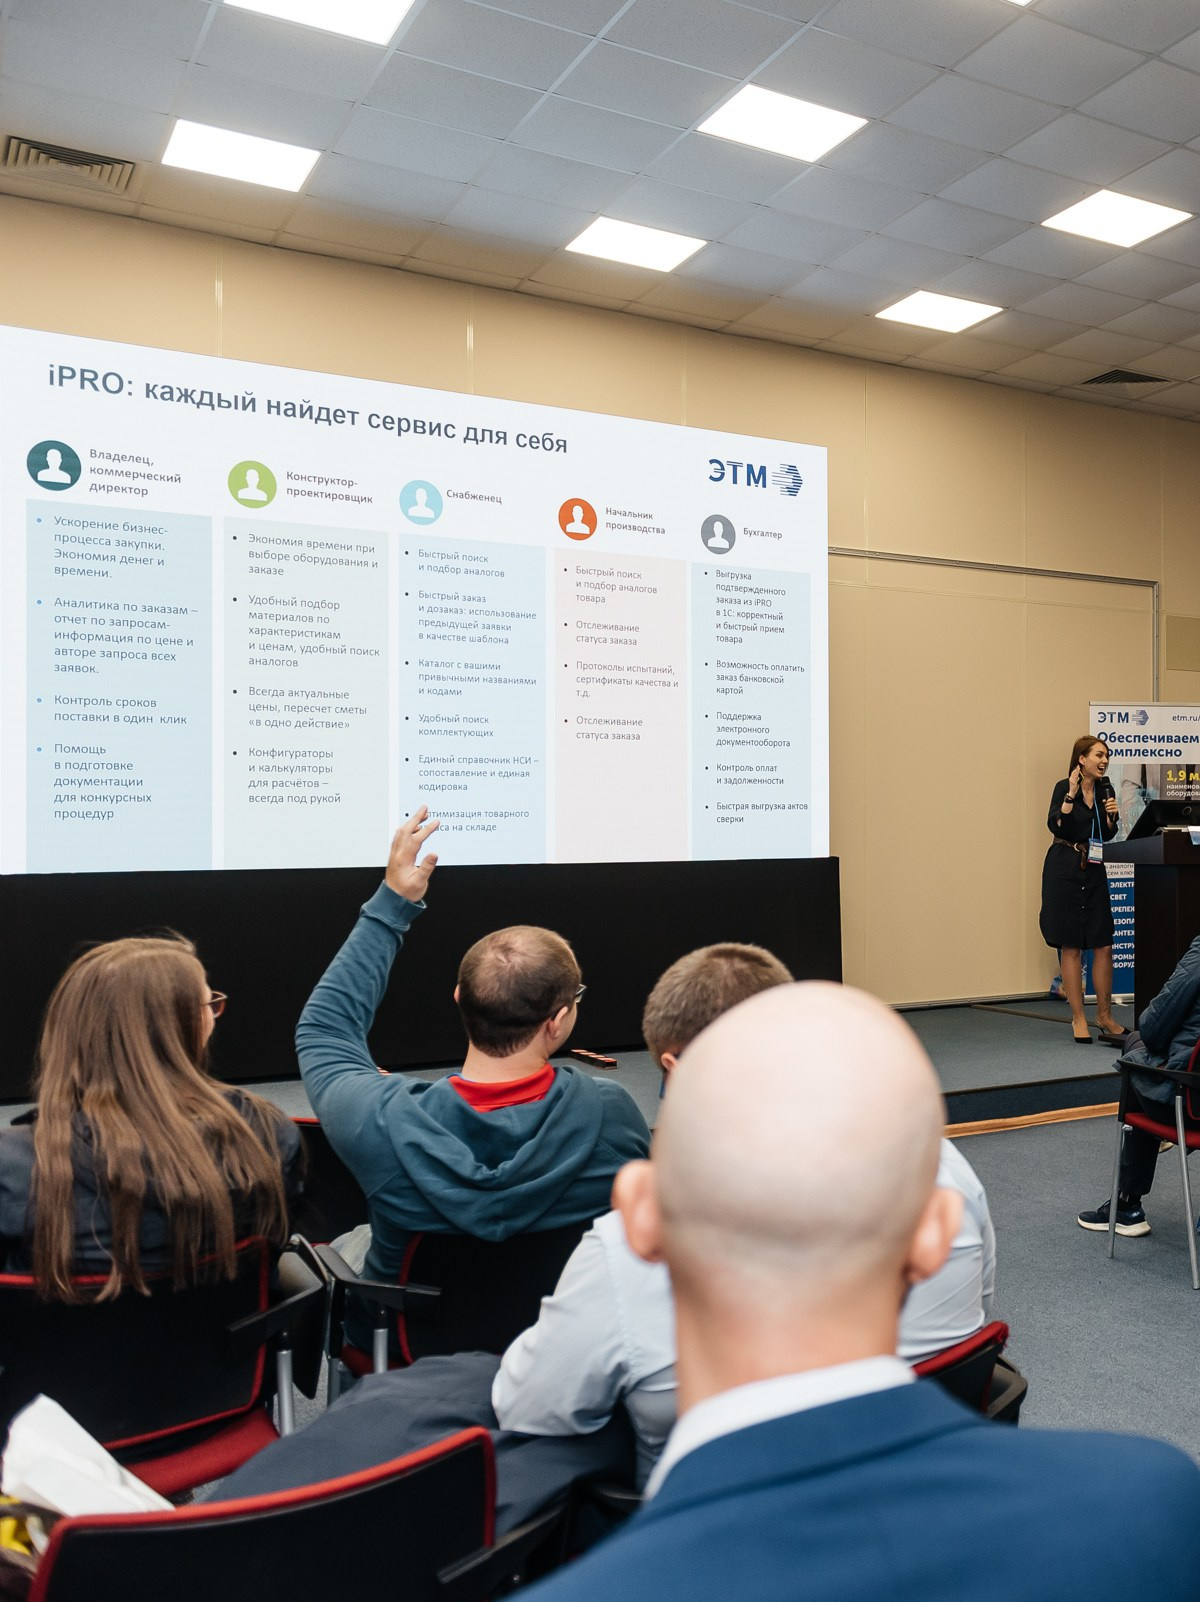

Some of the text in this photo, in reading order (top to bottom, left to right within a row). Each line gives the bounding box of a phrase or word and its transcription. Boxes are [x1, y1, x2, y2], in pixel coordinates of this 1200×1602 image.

[50, 364, 567, 453] iPRO: каждый найдет сервис для себя
[90, 448, 154, 466] Владелец,
[90, 467, 181, 483] коммерческий
[708, 458, 767, 488] ЭТМ
[286, 471, 357, 488] Конструктор-
[89, 483, 148, 497] директор
[286, 488, 373, 504] проектировщик
[446, 489, 502, 504] Снабженец
[606, 507, 653, 519] Начальник
[54, 516, 168, 534] Ускорение бизнес-
[605, 522, 665, 534] производства
[743, 527, 783, 540] Бухгалтер
[54, 534, 165, 550] процесса закупки.
[249, 533, 352, 551] Экономия времени
[54, 548, 154, 565] Экономия денег
[249, 549, 368, 567] выборе оборудования
[418, 549, 488, 562] Быстрый поиск
[54, 566, 112, 577] времени.
[248, 565, 284, 575] заказе
[427, 564, 505, 577] подбор аналогов
[576, 565, 642, 579] Быстрый поиск
[716, 569, 752, 580] Выгрузка
[584, 581, 657, 593] подбор аналогов
[715, 584, 786, 595] подтвержденного
[418, 590, 459, 601] Быстрый
[576, 594, 606, 604] товара
[54, 597, 188, 614] Аналитика заказам
[248, 594, 340, 611] Удобный подбор
[716, 596, 772, 607] заказа iPRO
[248, 612, 314, 622] материалов
[426, 605, 537, 619] дозаказ: использование
[736, 611, 783, 620] корректный
[54, 615, 170, 629] отчет запросам-
[419, 619, 511, 631] предыдущей заявки
[576, 620, 640, 632] Отслеживание
[723, 621, 785, 633] быстрый прием
[54, 630, 183, 646] информация цене
[248, 627, 341, 639] характеристикам
[426, 633, 509, 644] качестве шаблона
[575, 635, 637, 645] статуса заказа
[715, 635, 743, 644] товара
[54, 647, 176, 661] авторе запроса всех
[259, 643, 380, 656] ценам, удобный поиск
[248, 657, 299, 667] аналогов
[418, 659, 501, 670] Каталог вашими
[716, 660, 805, 672] Возможность оплатить
[54, 664, 99, 673] заявок.
[576, 661, 675, 675] Протоколы испытаний,
[418, 673, 480, 682] привычными
[576, 676, 671, 687] сертификаты качества
[739, 673, 784, 683] банковской
[249, 686, 349, 699] Всегда актуальные
[427, 688, 462, 696] кодами
[716, 685, 743, 695] картой
[54, 695, 157, 708] Контроль сроков
[249, 704, 367, 714] цены, пересчет сметы
[54, 713, 187, 724] поставки один клик
[418, 713, 460, 723] Удобный
[576, 715, 643, 726] Отслеживание
[716, 711, 762, 721] Поддержка
[1098, 712, 1129, 723] ЭТМ
[264, 719, 291, 728] одно
[294, 717, 349, 728] действие»
[418, 729, 493, 737] комплектующих
[716, 726, 770, 734] электронного
[576, 732, 609, 741] статуса
[1098, 731, 1199, 743] Обеспечиваем
[716, 738, 790, 748] документооборота
[54, 743, 106, 755] Помощь
[249, 748, 333, 759] Конфигураторы
[1108, 748, 1182, 757] омплексно
[418, 754, 455, 764] Единый
[513, 756, 531, 764] НСИ
[65, 762, 133, 771] подготовке
[258, 764, 332, 774] калькуляторы
[716, 763, 754, 772] Контроль
[724, 777, 784, 785] задолженности
[1166, 770, 1187, 782] 1,9
[53, 778, 143, 788] документации
[272, 778, 320, 789] расчётов
[419, 784, 467, 792] кодировка
[80, 794, 151, 804] конкурсных
[248, 793, 341, 804] всегда рукой
[717, 802, 749, 811] Быстрая
[751, 803, 786, 811] выгрузка
[54, 810, 114, 820] процедур
[428, 811, 481, 819] птимизация
[716, 816, 744, 824] сверки
[465, 824, 497, 832] складе
